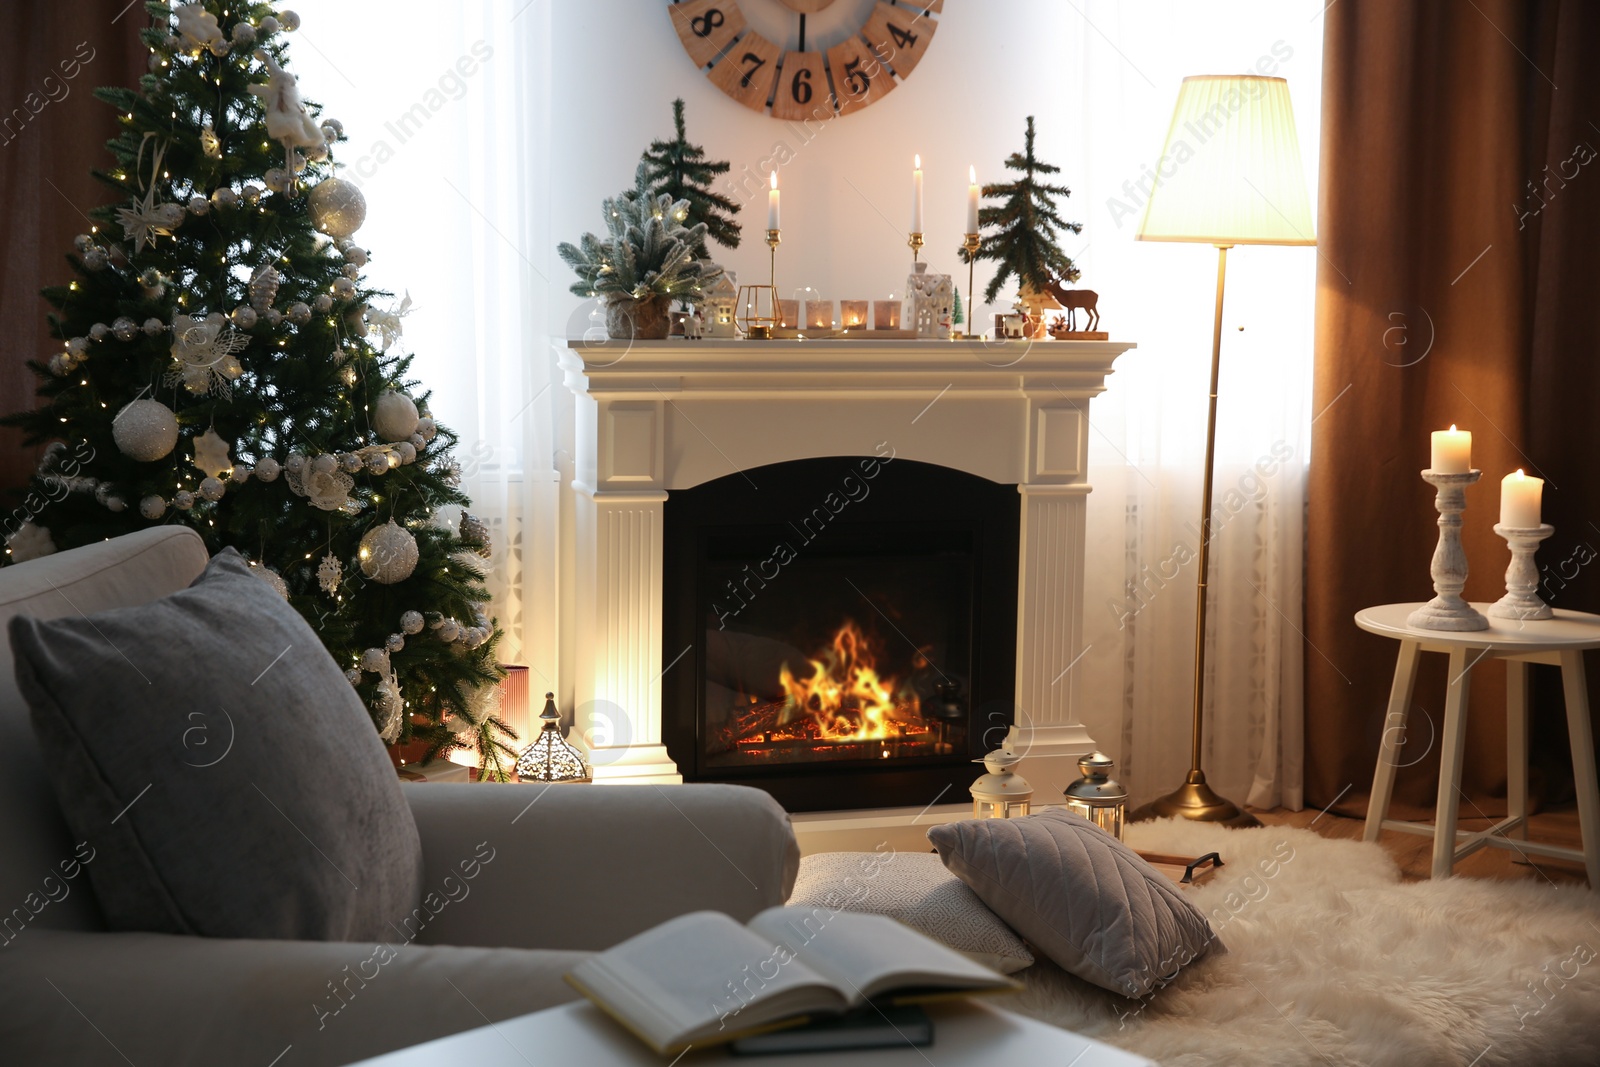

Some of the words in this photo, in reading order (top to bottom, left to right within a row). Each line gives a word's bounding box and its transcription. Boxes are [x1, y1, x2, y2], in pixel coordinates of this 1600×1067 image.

[691, 9, 724, 38] 8
[886, 21, 918, 49] 4
[741, 52, 766, 88] 7
[791, 68, 813, 105] 6
[845, 56, 871, 95] 5
